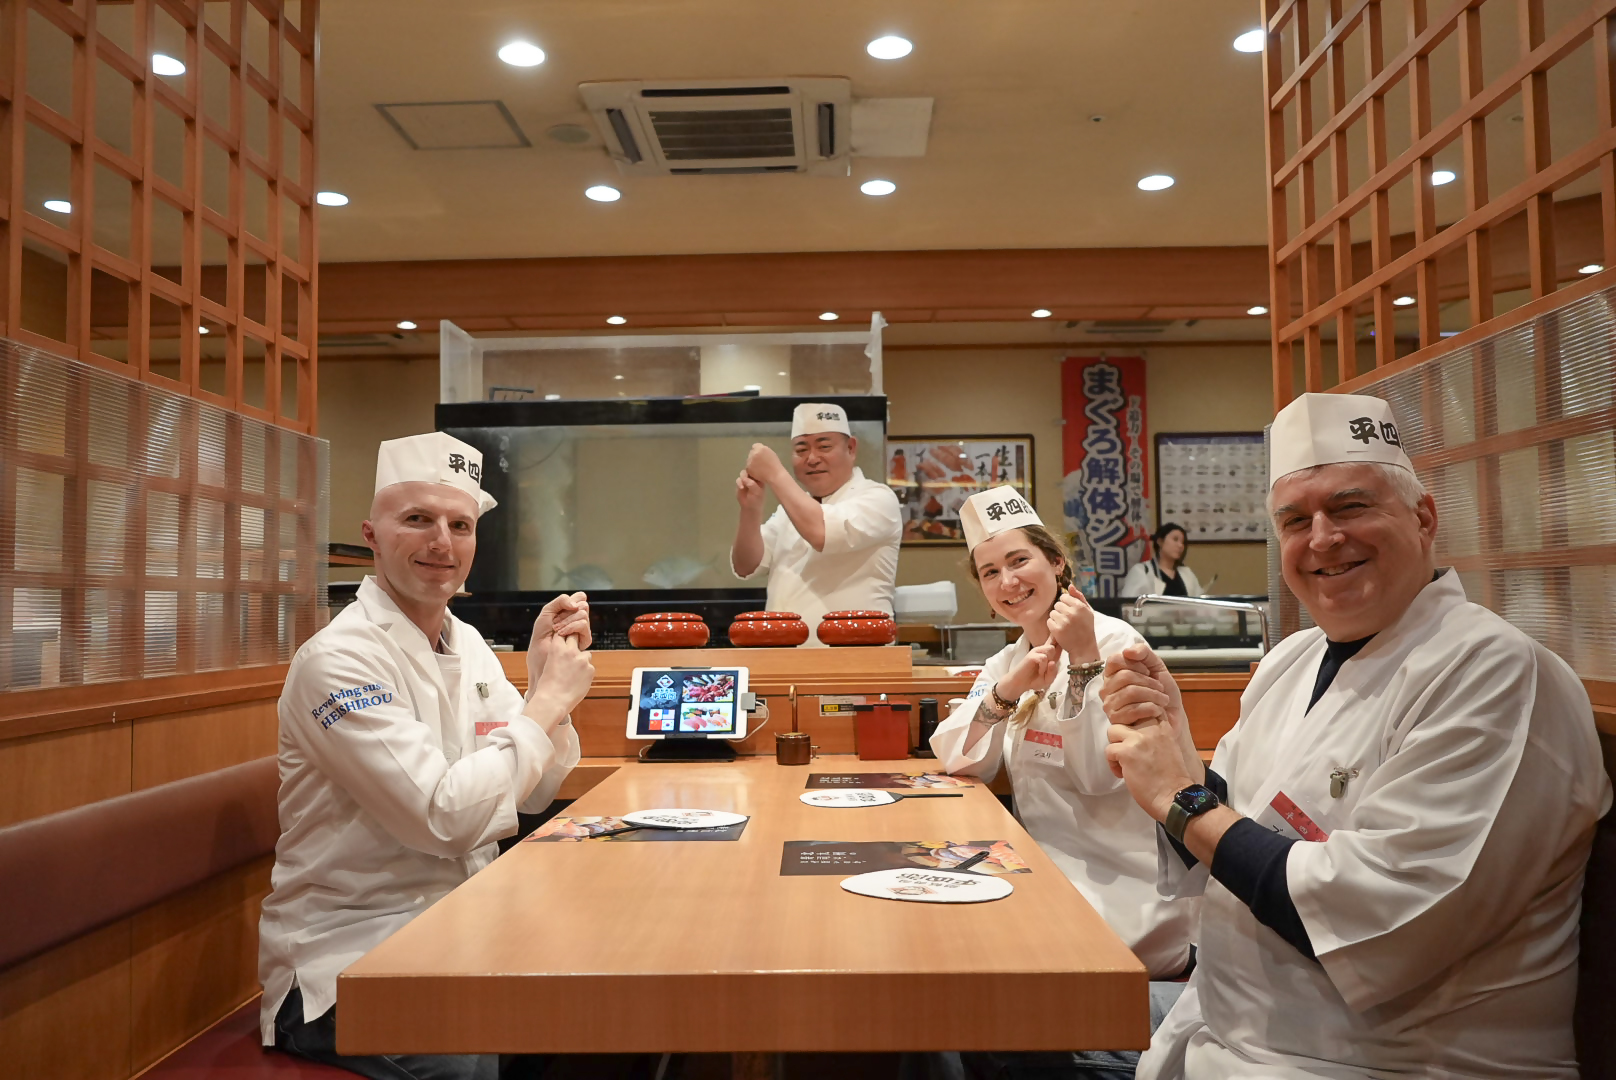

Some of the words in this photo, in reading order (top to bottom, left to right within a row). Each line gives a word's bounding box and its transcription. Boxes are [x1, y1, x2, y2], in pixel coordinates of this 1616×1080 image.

[1349, 416, 1405, 453] 平四
[448, 453, 481, 484] 平四
[312, 687, 362, 720] Revolving
[363, 683, 384, 692] sus
[320, 692, 393, 730] HEISHIROU
